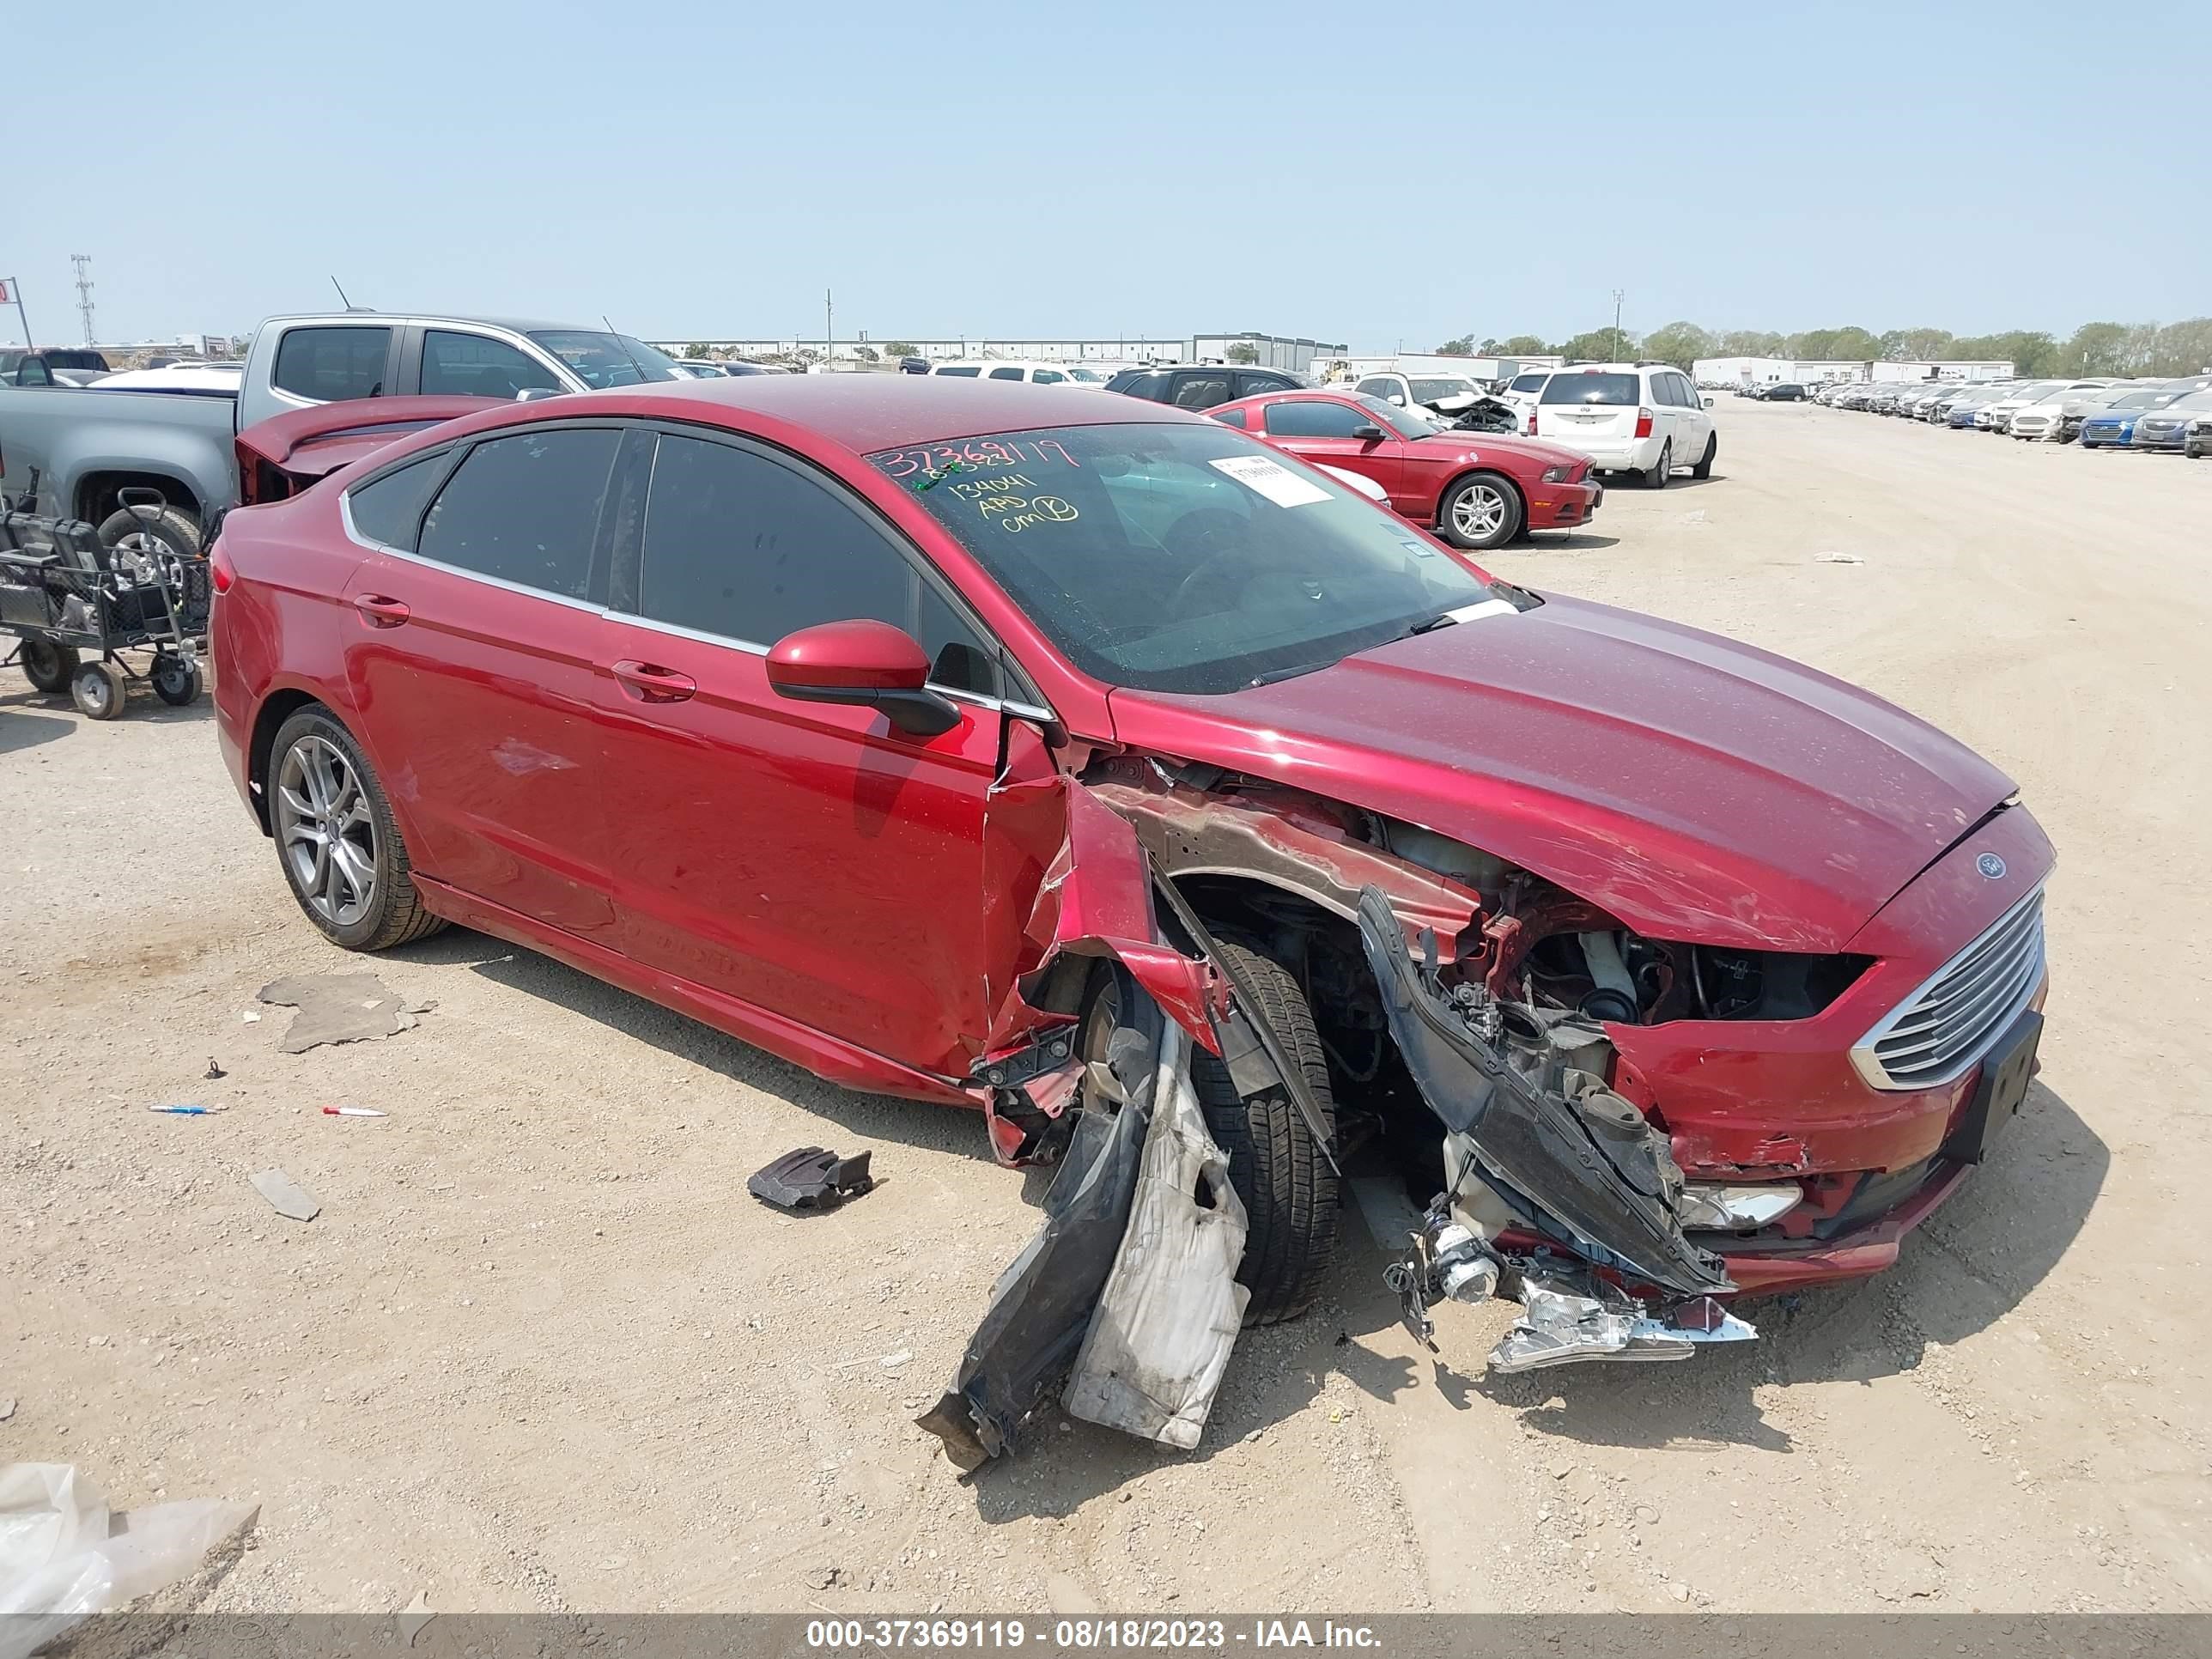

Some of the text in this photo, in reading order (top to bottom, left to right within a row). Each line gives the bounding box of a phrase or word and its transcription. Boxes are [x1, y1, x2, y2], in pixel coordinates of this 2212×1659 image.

[878, 440, 1080, 477] 37369119
[947, 473, 1037, 501] 134041
[978, 495, 1028, 520] APD
